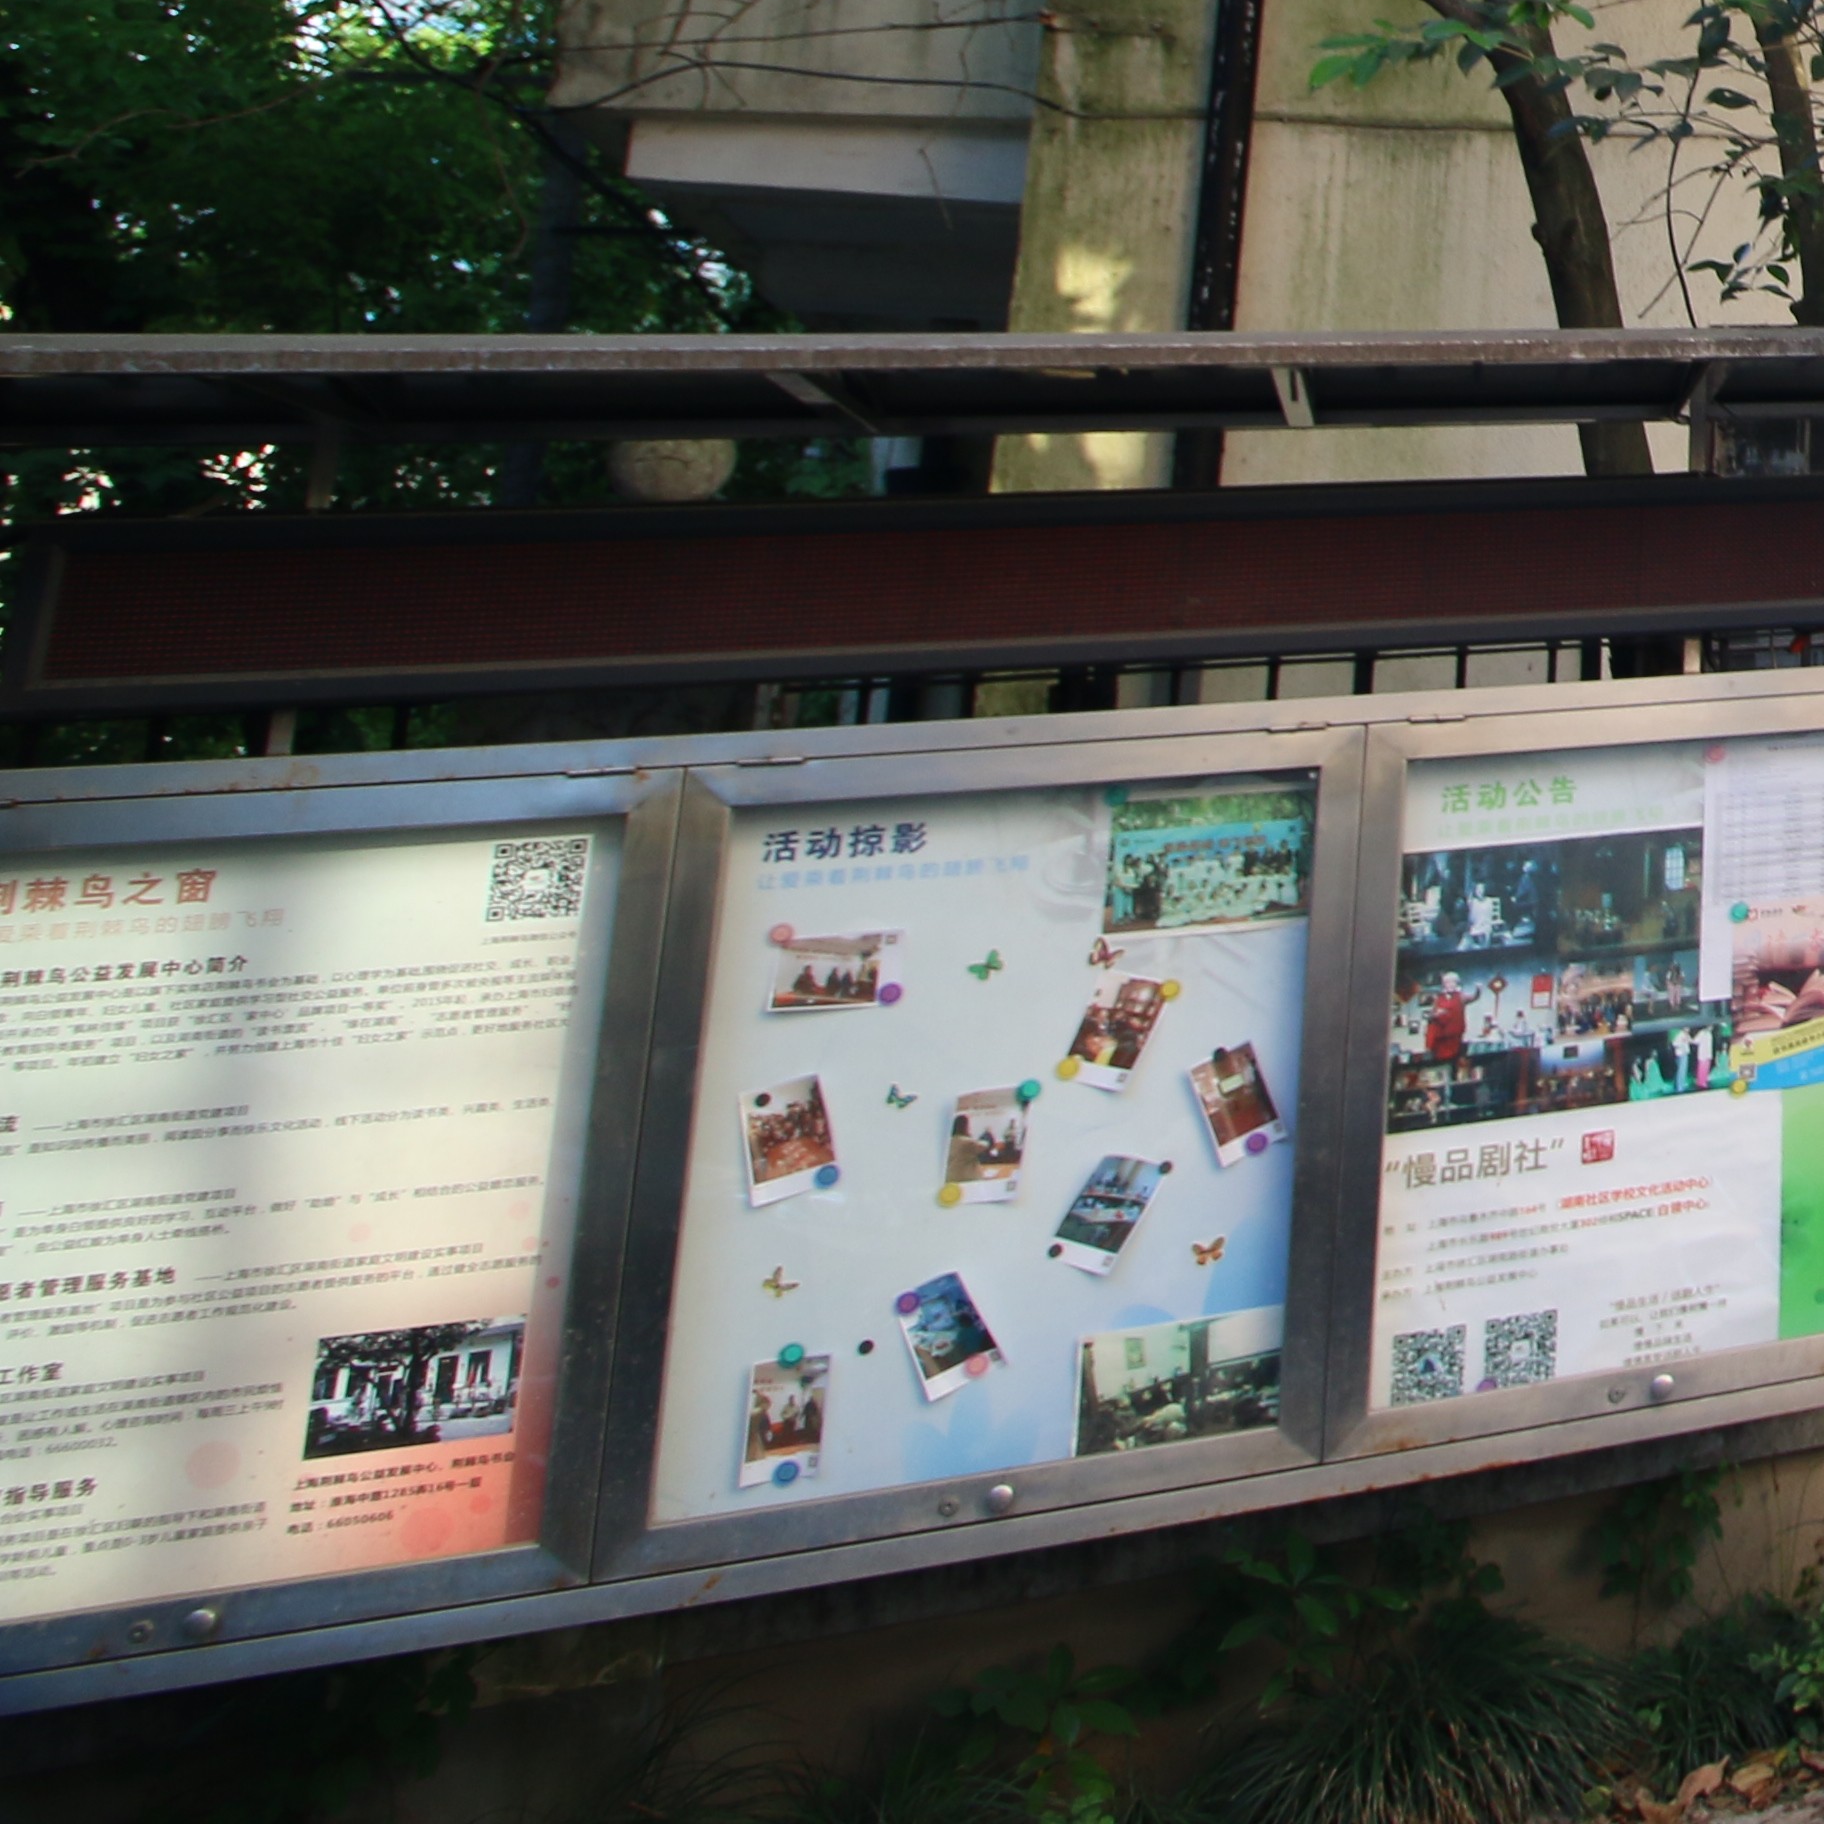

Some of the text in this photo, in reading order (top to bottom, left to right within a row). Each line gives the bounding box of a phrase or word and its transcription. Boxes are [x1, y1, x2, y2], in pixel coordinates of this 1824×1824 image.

[1441, 775, 1577, 815] 活动公告
[762, 822, 928, 864] 活动掠影
[1385, 1137, 1565, 1190] “慢品剧社”
[0, 1477, 99, 1507] 指导服务
